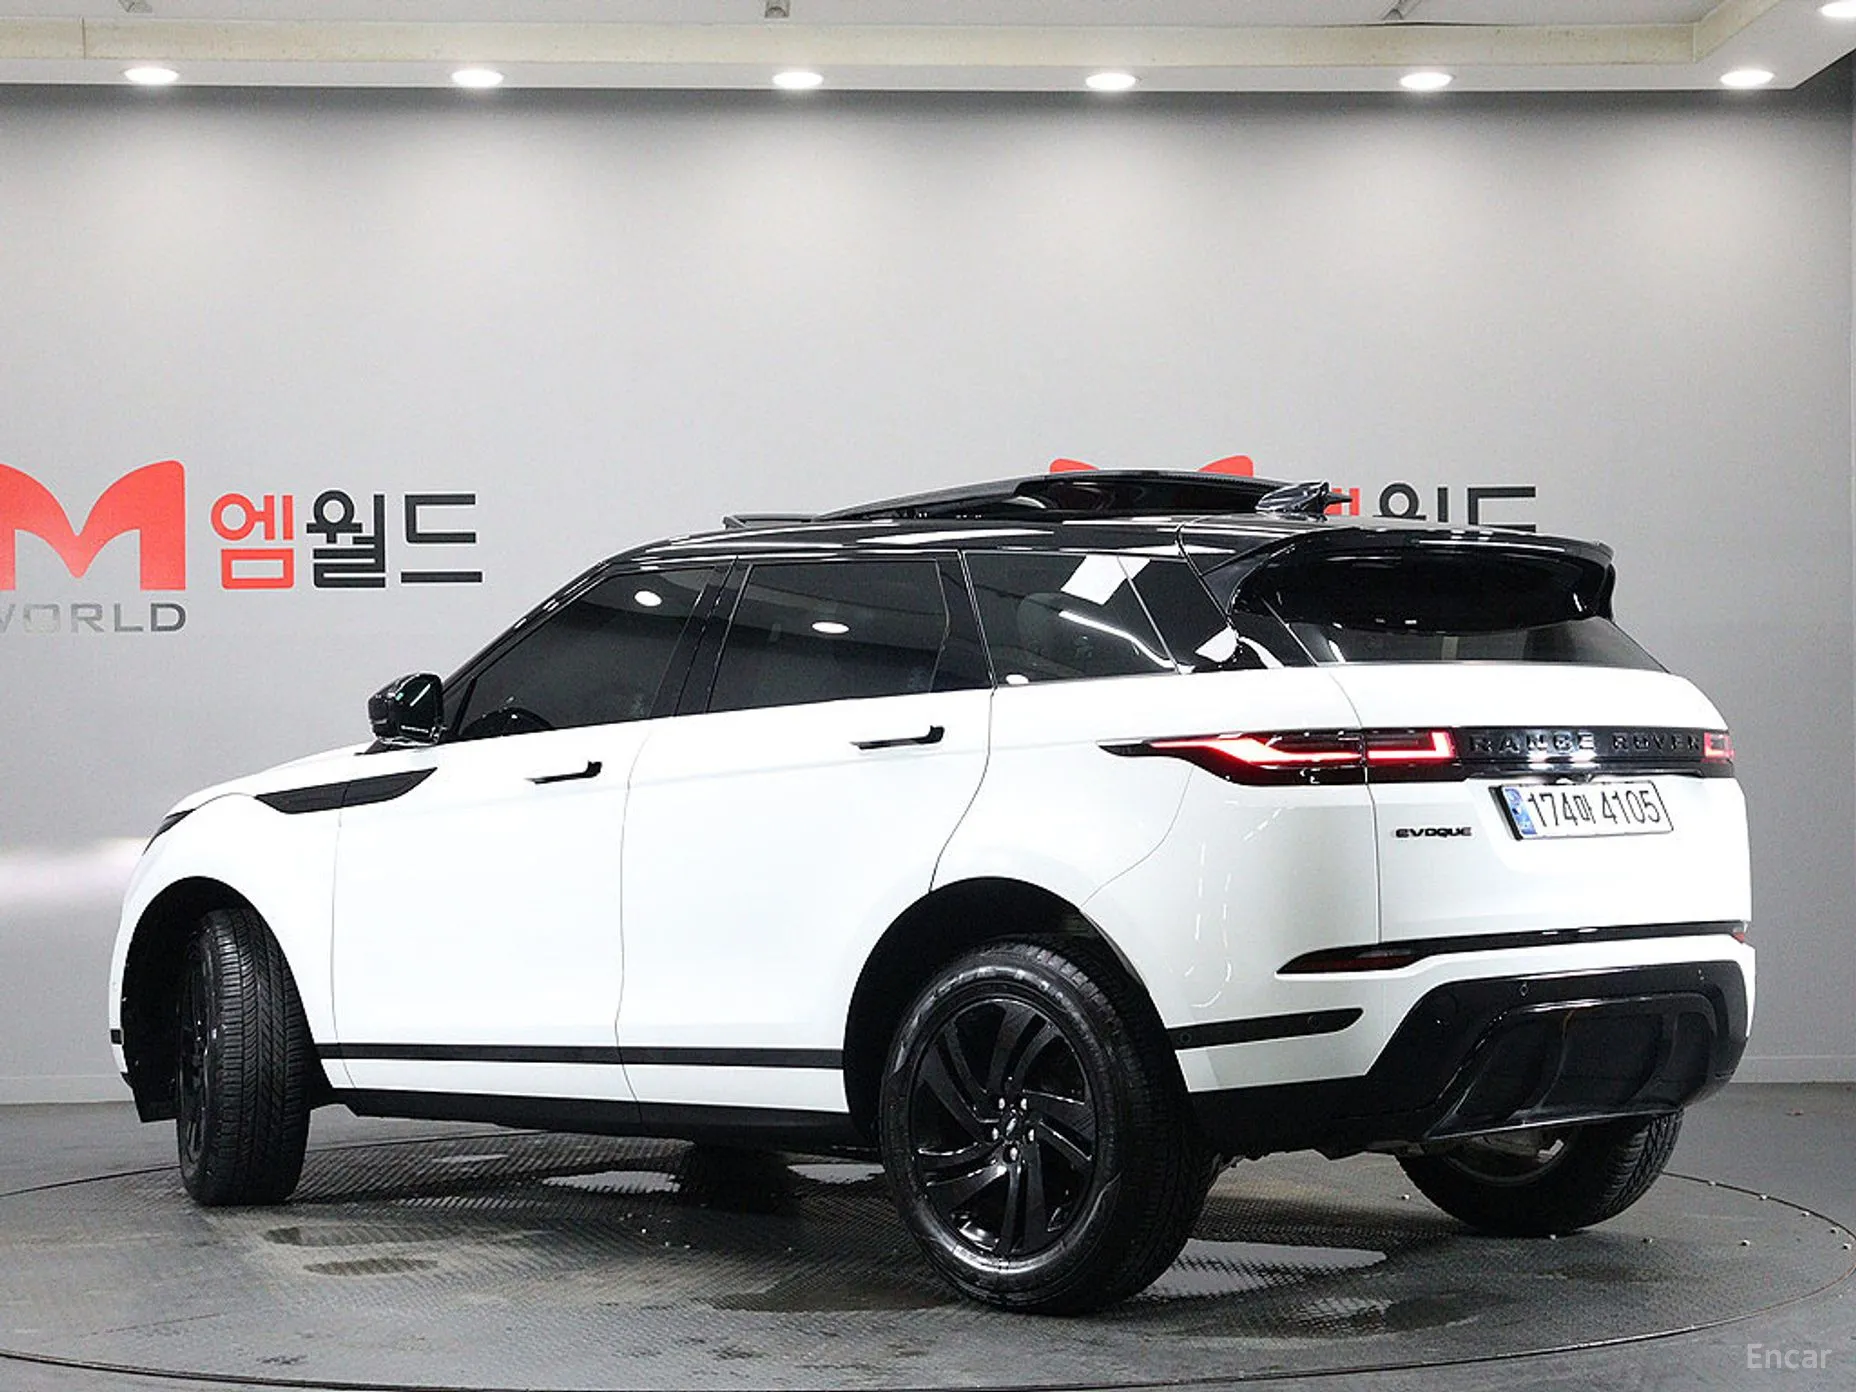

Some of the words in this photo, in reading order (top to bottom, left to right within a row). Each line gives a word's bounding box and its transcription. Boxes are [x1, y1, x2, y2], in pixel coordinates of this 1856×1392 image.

[0, 460, 186, 591] M
[210, 489, 483, 589] 엠월드
[1468, 732, 1597, 752] RANGE
[1611, 732, 1701, 752] ROVER
[1601, 790, 1660, 825] 4105
[1395, 826, 1472, 838] EVOQUE
